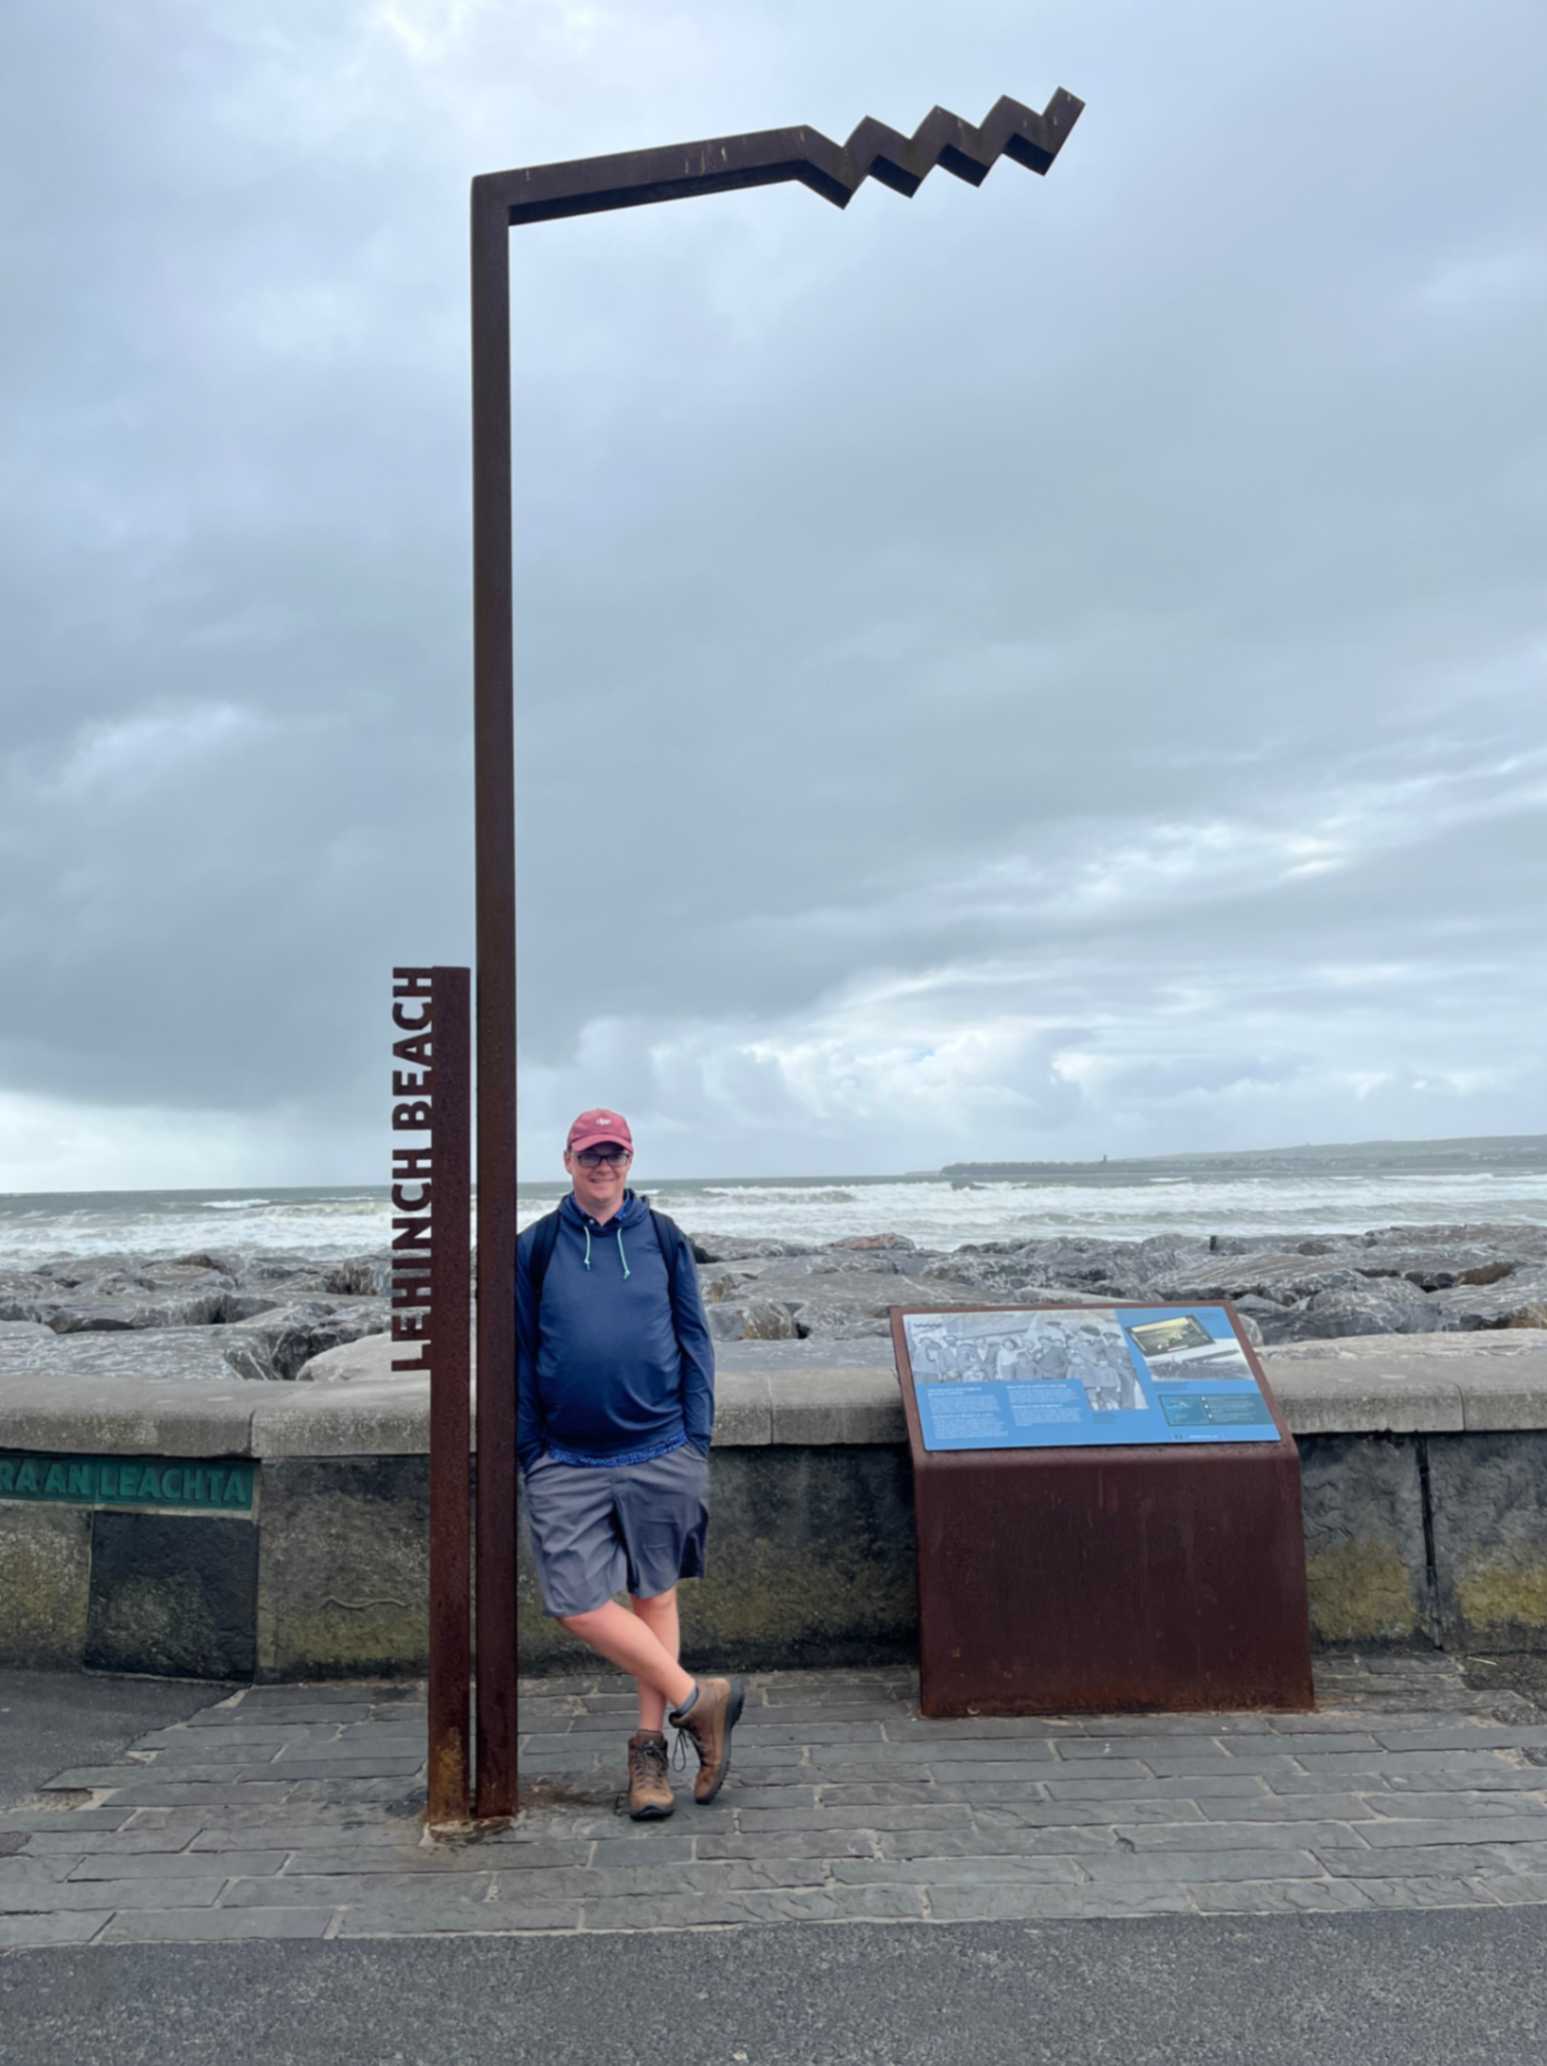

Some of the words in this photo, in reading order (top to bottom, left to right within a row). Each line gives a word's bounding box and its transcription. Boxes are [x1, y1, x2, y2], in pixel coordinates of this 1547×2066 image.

[392, 967, 432, 1130] BEACH
[392, 1148, 432, 1372] LEHINCH
[46, 1463, 90, 1494] AN
[100, 1466, 247, 1503] LEACHTA
